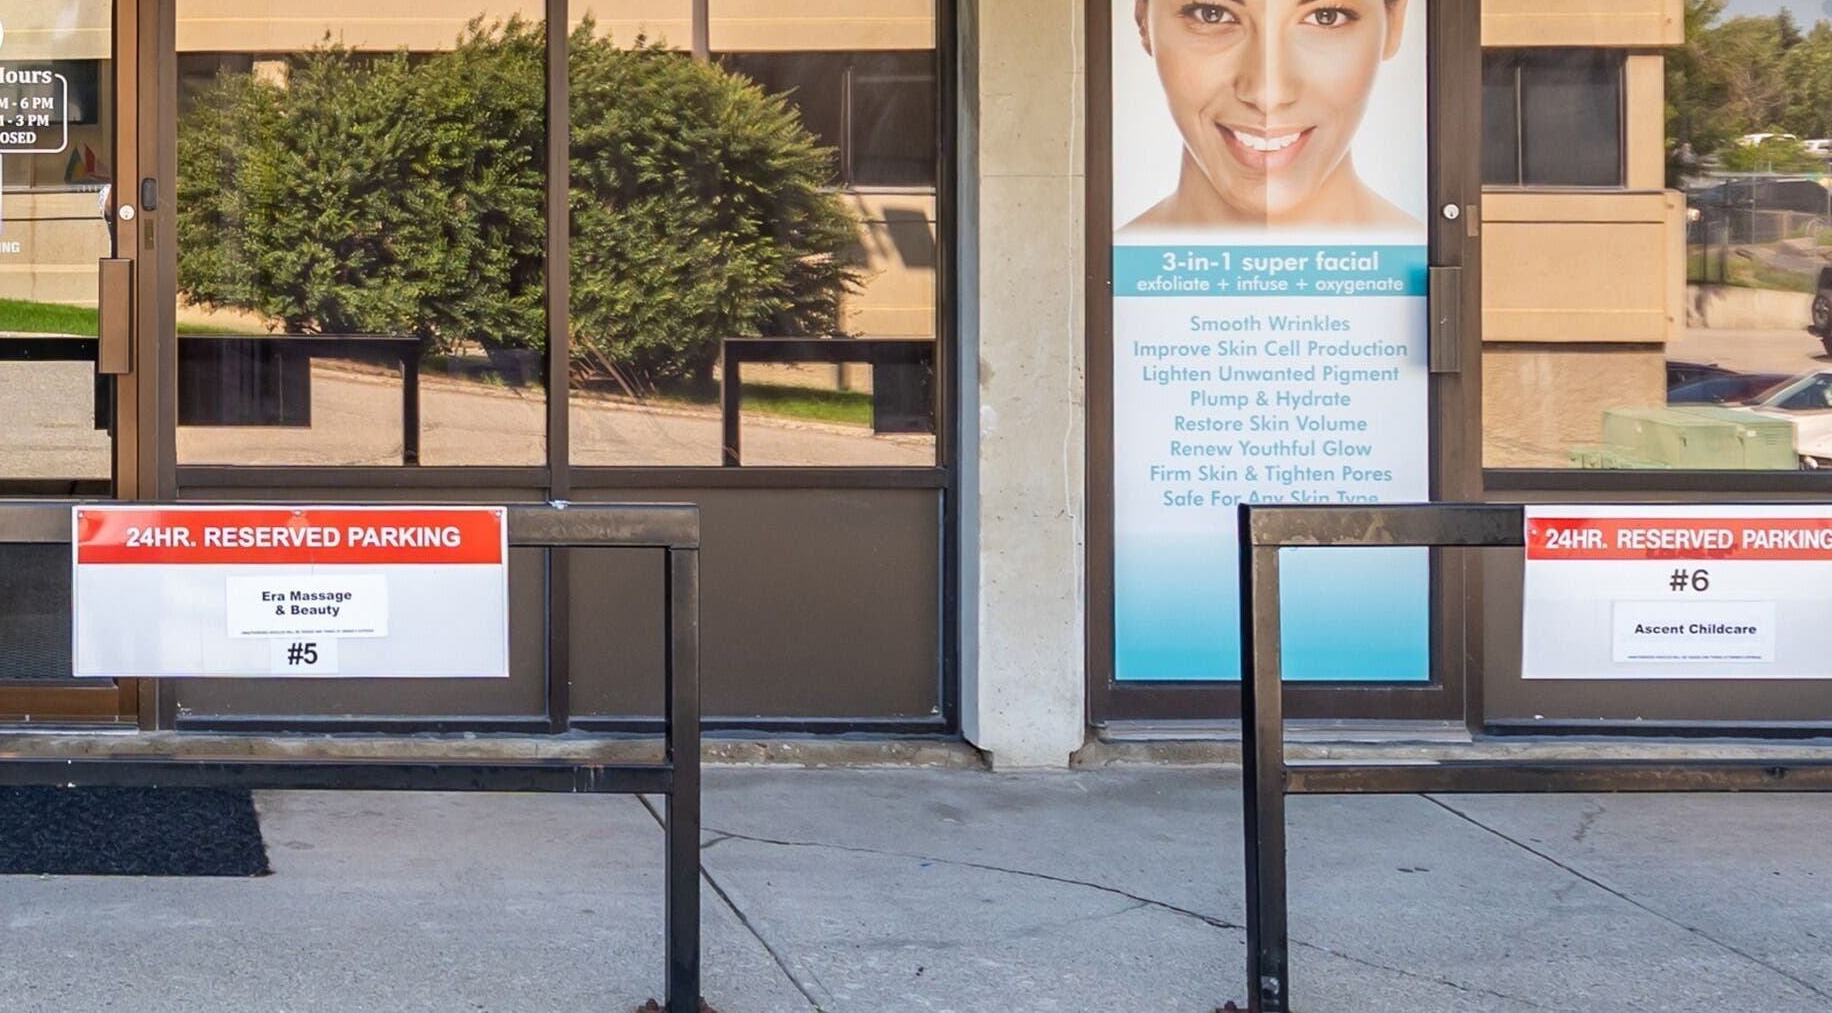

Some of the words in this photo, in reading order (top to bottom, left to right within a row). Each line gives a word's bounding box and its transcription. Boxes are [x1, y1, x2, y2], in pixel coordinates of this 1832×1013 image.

[20, 97, 29, 109] 6
[32, 97, 54, 109] PM
[16, 114, 25, 127] 3
[28, 114, 50, 127] PM
[1162, 251, 1231, 272] 3-in-1
[1242, 255, 1309, 276] super
[1315, 251, 1379, 272] facial
[1137, 276, 1209, 291] exfoliate
[1217, 279, 1230, 291] +
[1237, 276, 1288, 291] infuse
[1296, 279, 1308, 291] +
[1315, 277, 1403, 295] oxygenate
[1190, 315, 1261, 332] Smooth
[1268, 315, 1350, 332] Wrinkles
[1134, 340, 1211, 360] Improve
[1218, 340, 1257, 357] Skin
[1264, 340, 1300, 357] Cell
[1308, 340, 1408, 357] Production
[1142, 365, 1212, 386] Lighten
[1219, 365, 1317, 382] Unwanted
[1323, 365, 1400, 387] Pigment
[1190, 390, 1249, 410] Plump
[1256, 391, 1268, 407] &
[1276, 390, 1351, 410] Hydrate
[1174, 415, 1243, 432] Restore
[1250, 415, 1289, 432] Skin
[1296, 415, 1368, 432] Volume
[1170, 440, 1232, 457] Renew
[1239, 440, 1316, 457] Youthful
[1323, 440, 1372, 457] Glow
[1150, 465, 1191, 482] Firm
[1199, 465, 1238, 482] Skin
[1245, 466, 1258, 482] &
[1264, 465, 1335, 485] Tighten
[1342, 466, 1392, 482] Pores
[1163, 490, 1204, 507] Safe
[1211, 490, 1241, 506] For
[1290, 490, 1330, 504] Skin
[126, 527, 196, 548] 24HR.
[203, 526, 341, 548] RESERVED
[347, 525, 461, 548] PARKING
[1545, 528, 1607, 549] 24HR.
[1617, 528, 1734, 550] RESERVED
[1741, 528, 1832, 550] PARKING
[1669, 569, 1710, 592] #6
[262, 591, 285, 601] Era
[290, 591, 352, 602] Massage
[275, 605, 285, 615] &
[291, 605, 340, 617] Beauty
[1634, 623, 1684, 635] Ascent
[1688, 623, 1757, 635] Childcare
[287, 642, 318, 665] #5
